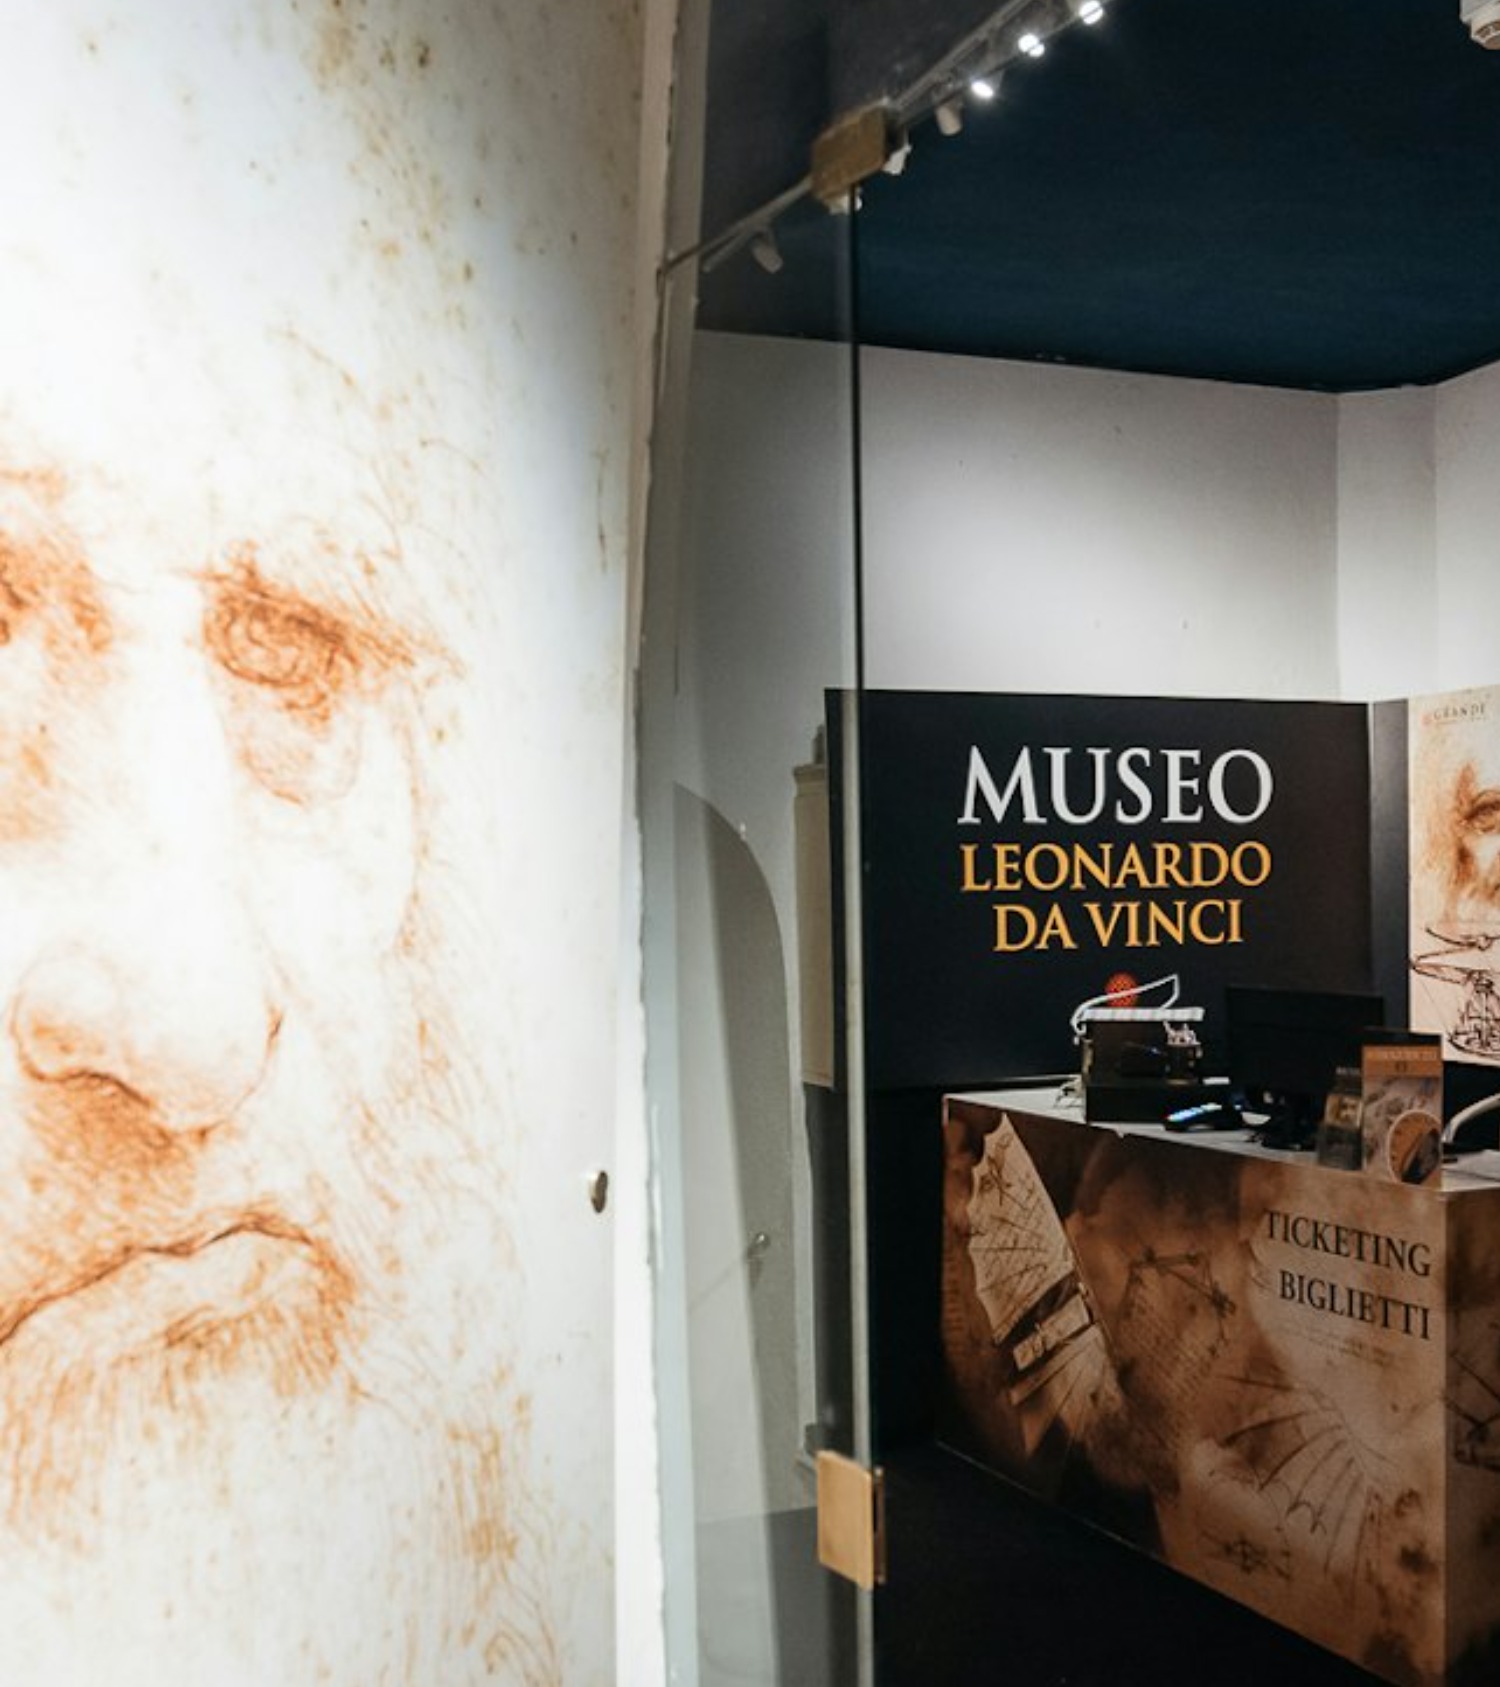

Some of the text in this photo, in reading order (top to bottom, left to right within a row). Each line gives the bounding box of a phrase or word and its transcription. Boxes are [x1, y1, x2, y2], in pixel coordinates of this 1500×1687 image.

[957, 744, 1274, 825] MUSEO
[959, 841, 1272, 892] LEONARDO
[993, 899, 1243, 952] DA VINCI
[1263, 1208, 1431, 1277] TICKETING
[1280, 1269, 1430, 1340] BIGLIETTI
